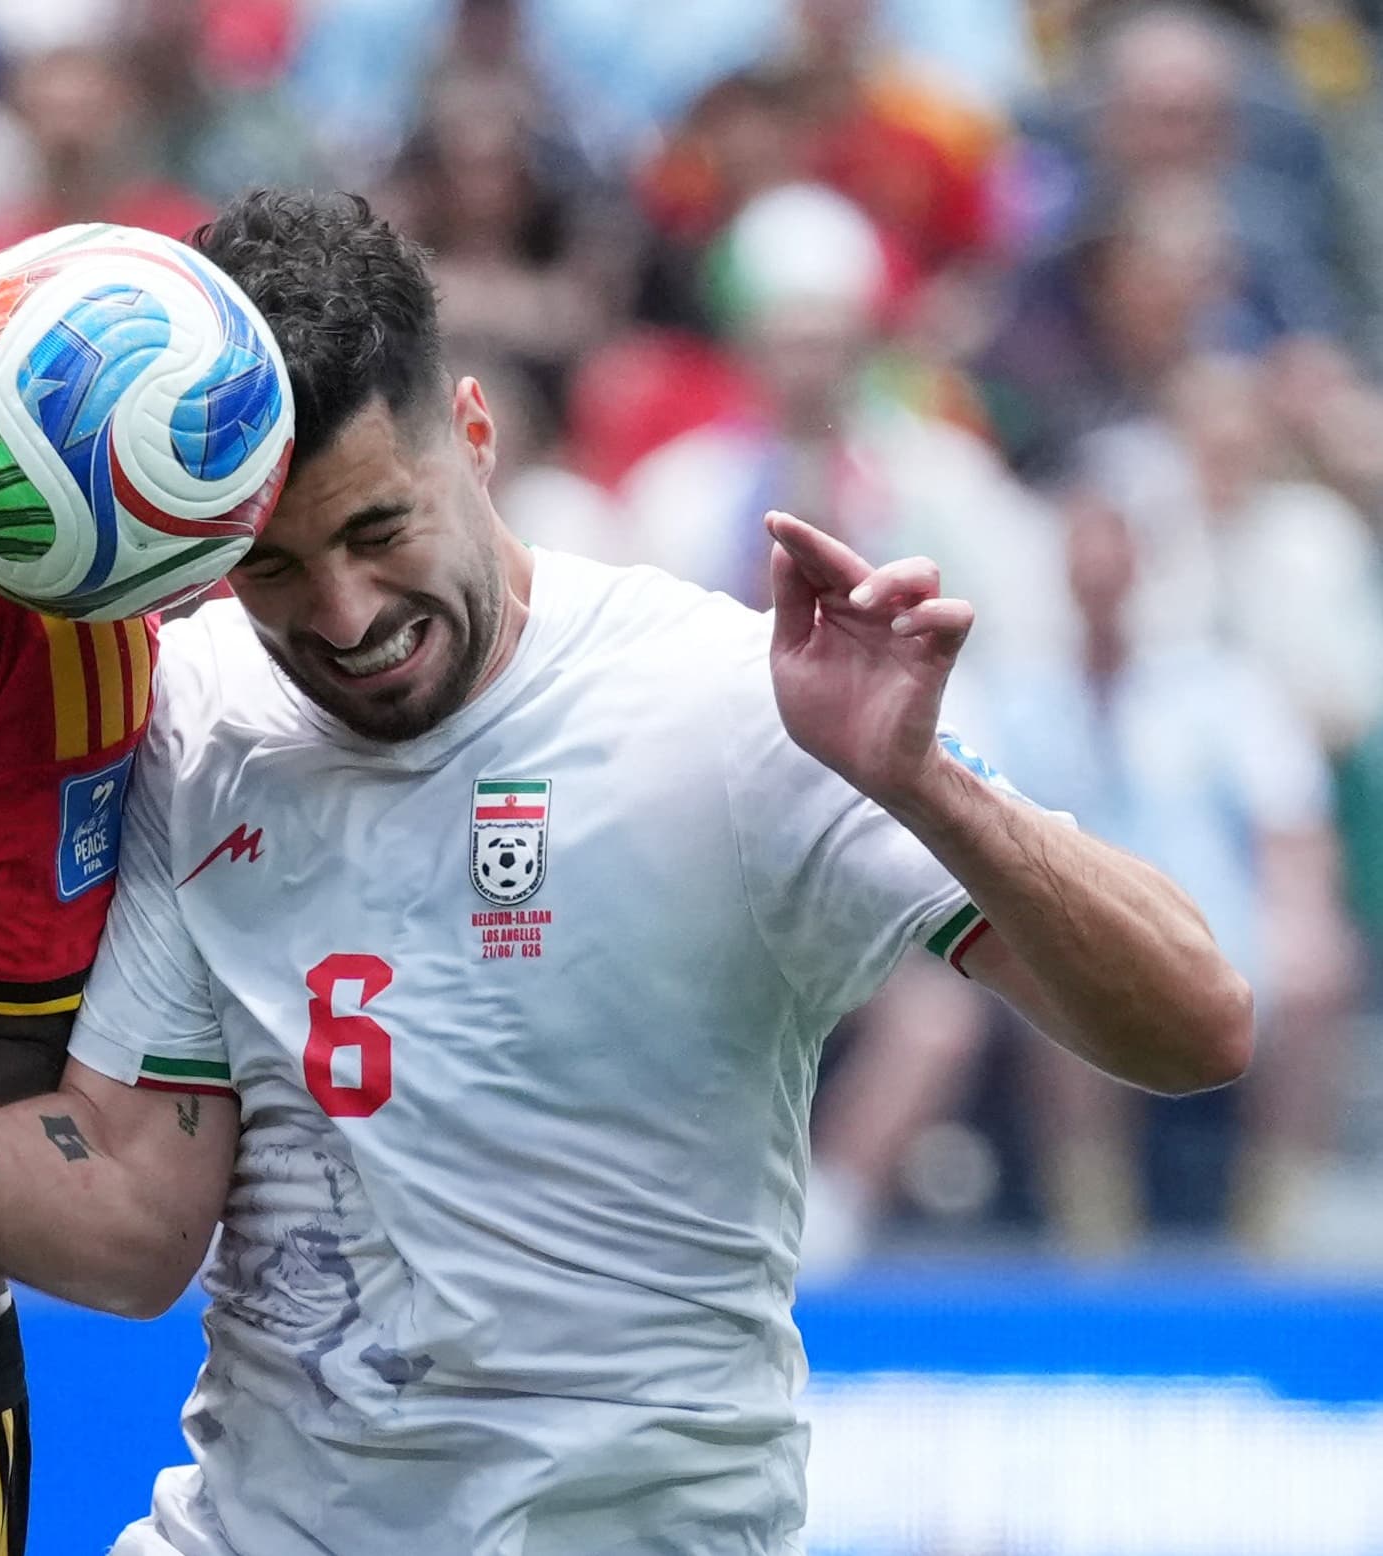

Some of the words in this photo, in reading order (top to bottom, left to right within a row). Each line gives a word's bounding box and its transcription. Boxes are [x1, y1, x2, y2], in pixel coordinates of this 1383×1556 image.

[74, 828, 109, 865] PEACE
[83, 857, 103, 877] FIFA
[482, 929, 499, 943] LOS
[500, 927, 542, 942] ANGELES
[303, 953, 393, 1118] 6
